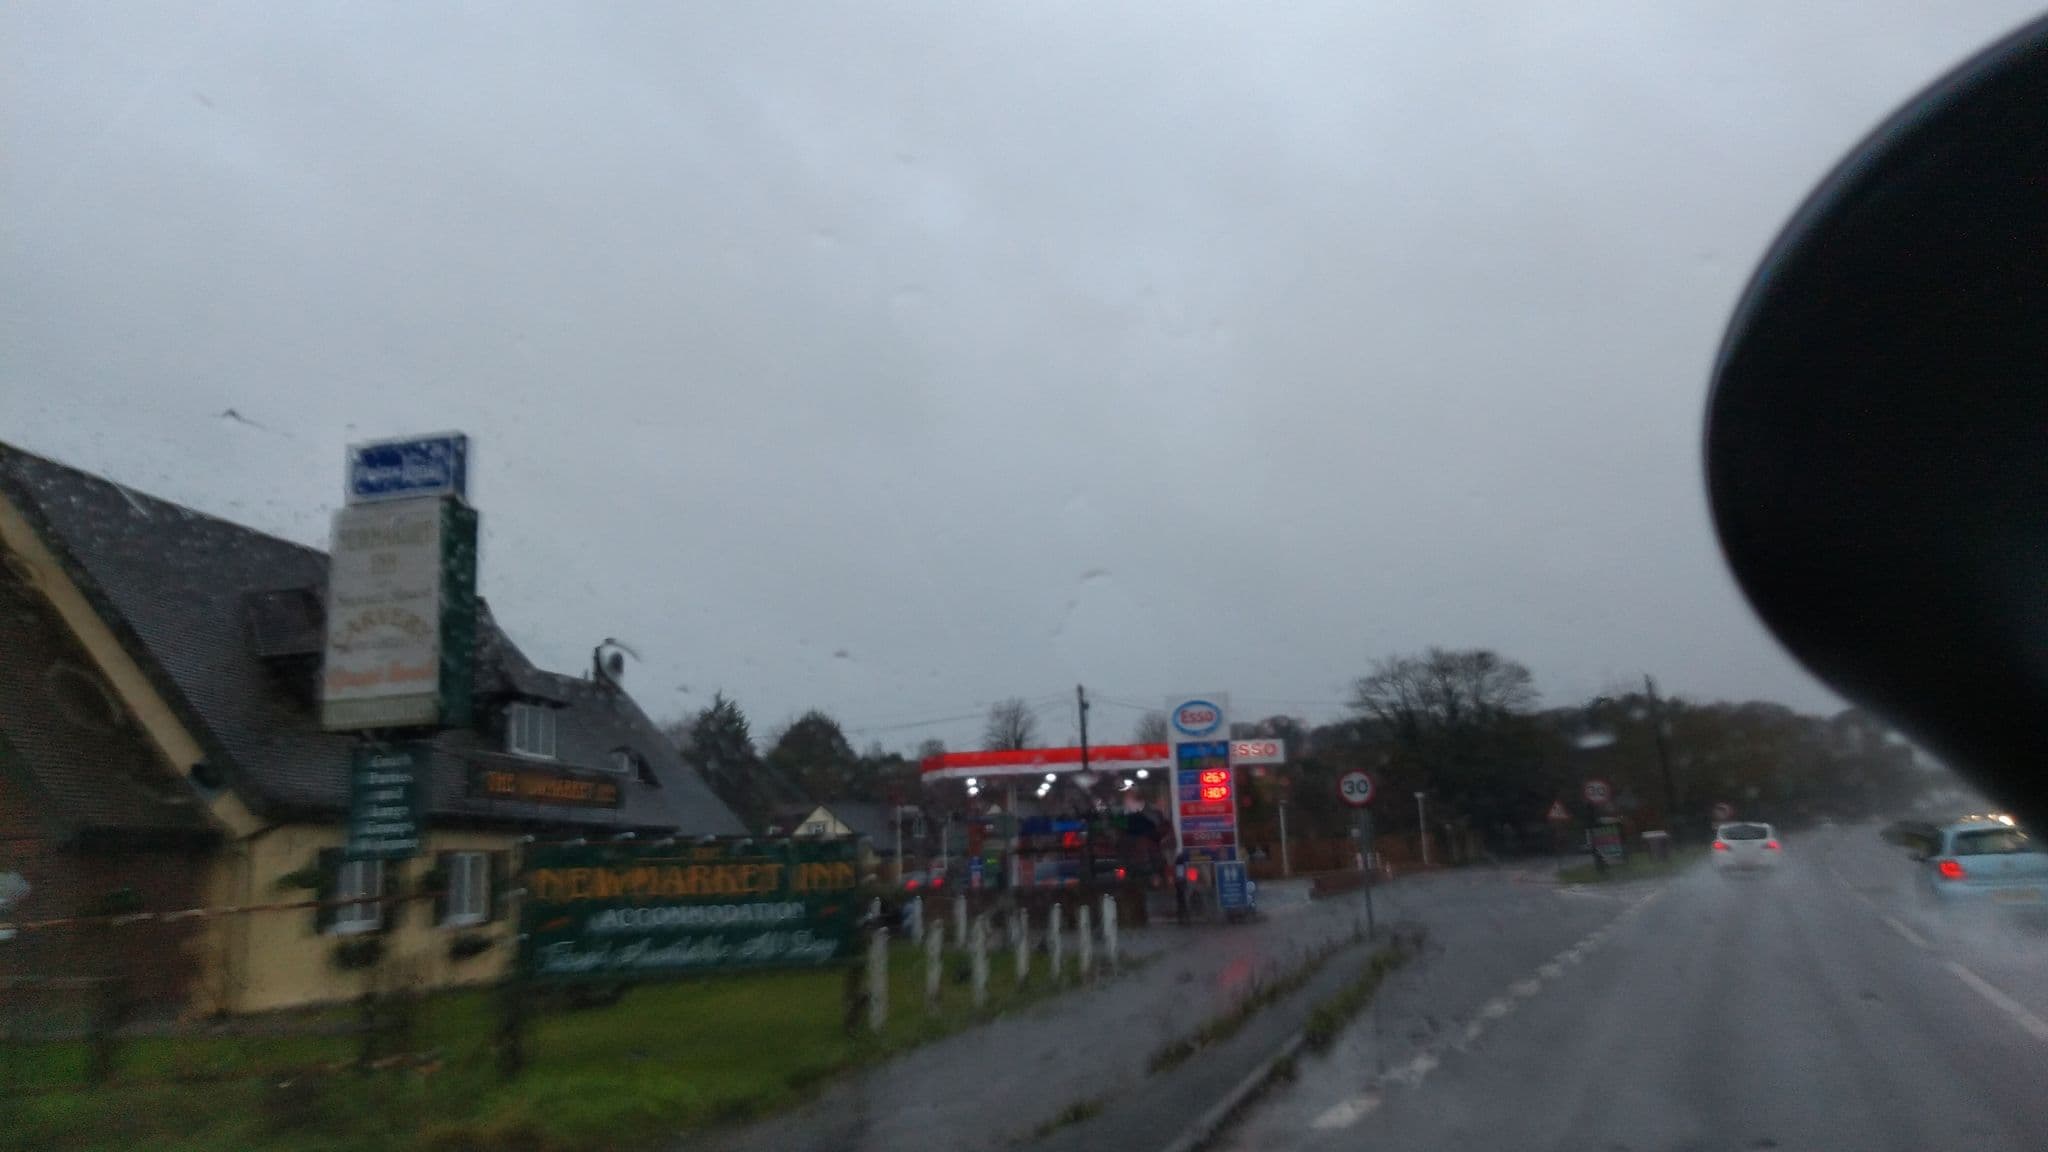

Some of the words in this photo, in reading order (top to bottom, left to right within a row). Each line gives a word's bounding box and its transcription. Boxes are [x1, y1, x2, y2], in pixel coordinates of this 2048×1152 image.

[1181, 710, 1216, 725] Esso
[1343, 779, 1369, 795] 30
[535, 863, 785, 899] NEWMARKET
[794, 861, 857, 891] INN
[592, 902, 806, 928] ACCOMMODATION
